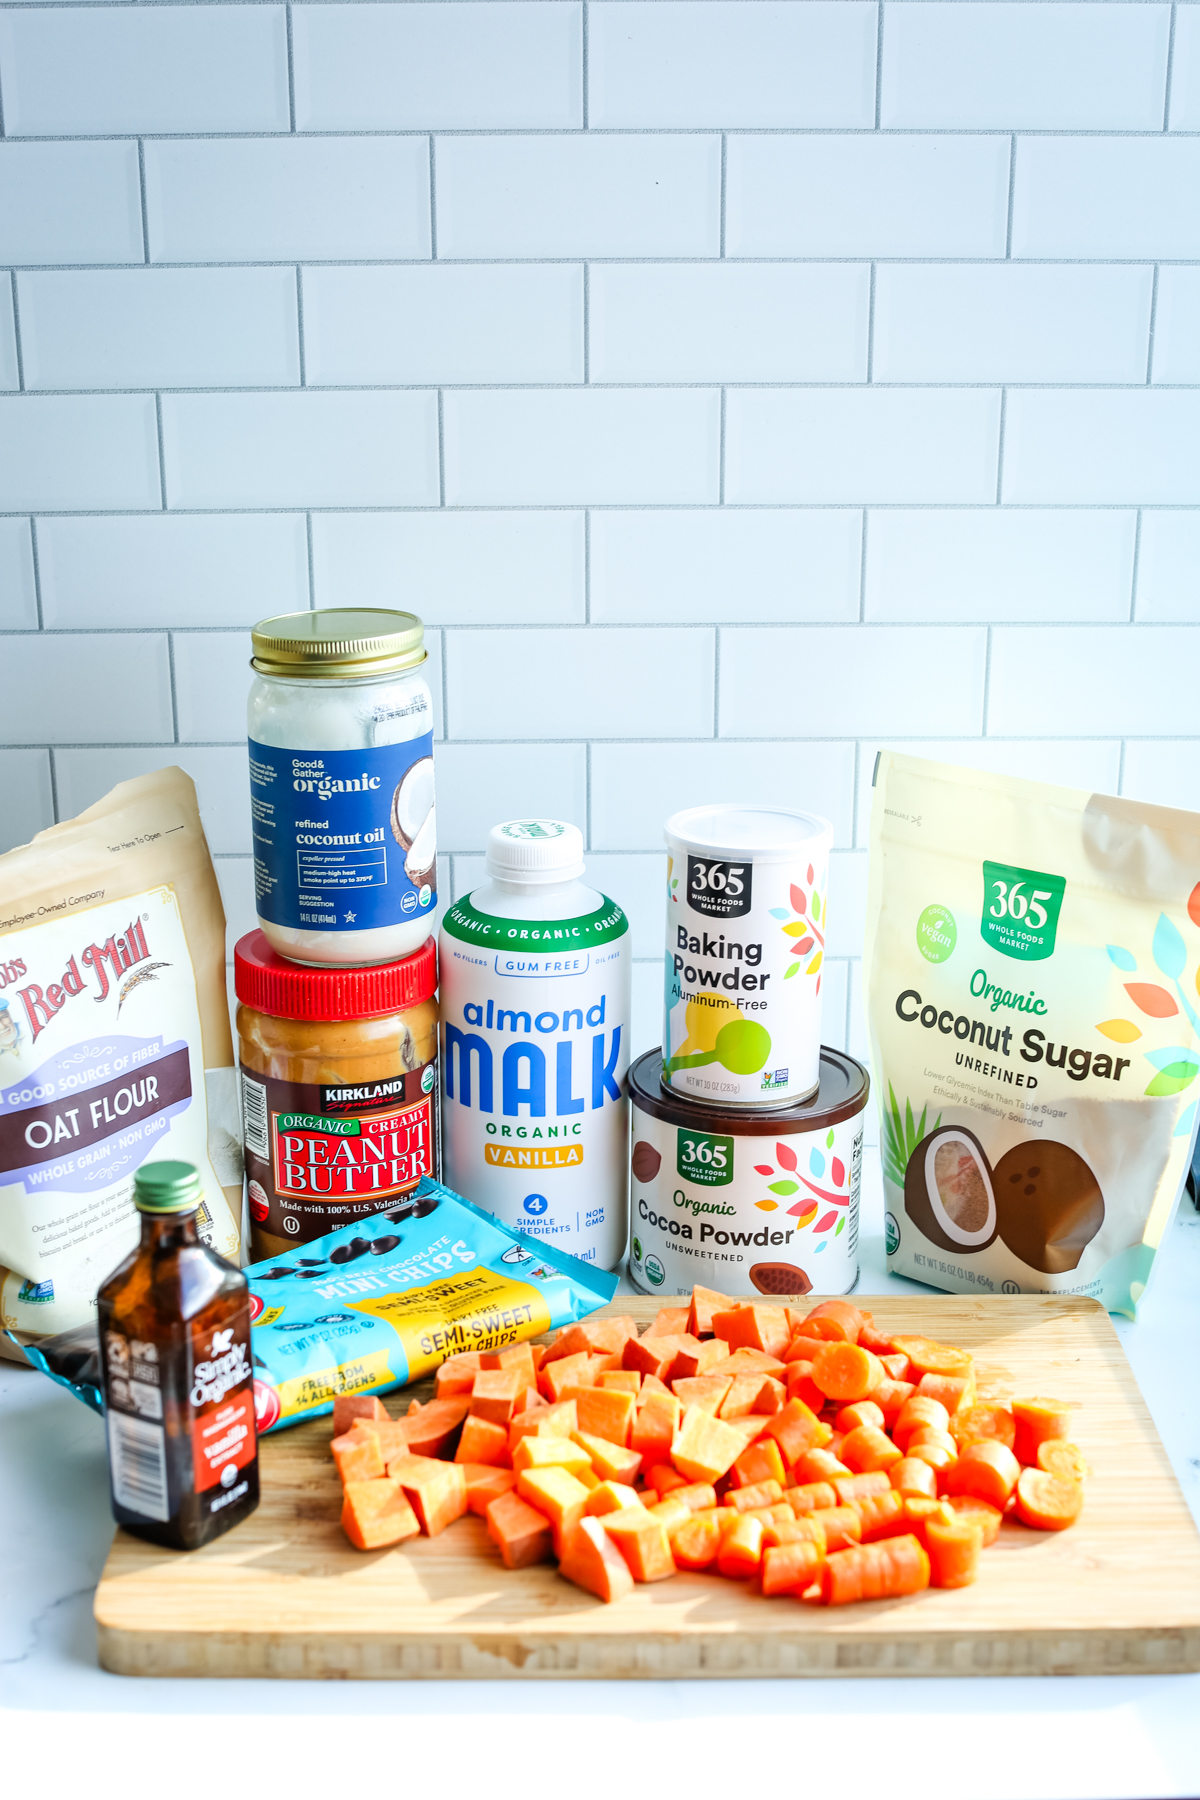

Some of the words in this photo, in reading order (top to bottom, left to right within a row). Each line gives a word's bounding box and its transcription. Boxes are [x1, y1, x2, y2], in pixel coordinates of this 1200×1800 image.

[292, 768, 325, 778] Gather
[293, 773, 381, 801] organic
[295, 819, 329, 829] refined
[296, 832, 362, 846] coconut
[364, 827, 385, 844] oil
[120, 840, 136, 850] Here
[135, 836, 145, 846] To
[144, 832, 162, 842] Open
[692, 863, 744, 895] 365
[68, 888, 105, 907] Company
[691, 893, 715, 903] WHOLE
[717, 898, 744, 906] FOODS
[701, 903, 731, 912] MARKET
[989, 880, 1052, 929] 365
[451, 909, 492, 934] ORGANIC
[507, 928, 581, 939] ORGANIC
[928, 907, 954, 927] COCONUT
[677, 924, 763, 966] Baking
[921, 922, 952, 948] vegan
[988, 922, 1015, 937] WHOLE
[1016, 931, 1044, 945] FOODS
[998, 935, 1030, 952] MARKET
[462, 954, 488, 967] FILLERS
[506, 961, 539, 971] GUM
[544, 959, 580, 971] FREE
[608, 951, 621, 961] FREE
[16, 953, 88, 1045] Red
[82, 915, 152, 1003] Mill
[673, 954, 771, 991] Powder
[671, 983, 768, 1011] Aluminum-Free
[969, 968, 1048, 1016] Organic
[463, 994, 606, 1033] almond
[895, 989, 1013, 1057] Coconut
[1019, 1028, 1131, 1082] Sugar
[8, 1083, 55, 1106] GOOD
[58, 1064, 111, 1092] SOURCE
[113, 1057, 130, 1071] OF
[132, 1042, 160, 1066] FIBER
[445, 1021, 622, 1117] MALK
[686, 1076, 695, 1085] NET
[695, 1078, 703, 1087] WT
[704, 1081, 710, 1089] 10
[712, 1082, 719, 1090] OZ
[955, 1052, 1038, 1089] UNREFINED
[325, 1080, 403, 1102] KIRKLAND
[325, 1095, 403, 1111] Signature
[923, 1067, 946, 1081] Lower
[946, 1075, 976, 1093] Glycemic
[977, 1086, 994, 1100] Index
[995, 1093, 1013, 1106] Than
[1015, 1098, 1039, 1112] Table
[1041, 1105, 1068, 1119] Sugar
[24, 1108, 81, 1149] OAT
[89, 1075, 160, 1129] FLOUR
[283, 1115, 352, 1134] ORGANIC
[368, 1107, 425, 1134] CREAMY
[933, 1085, 962, 1103] Ethically
[963, 1096, 969, 1104] &
[969, 1098, 1006, 1120] Sustainably
[1007, 1111, 1044, 1128] Sourced
[282, 1119, 428, 1165] PEANUT
[485, 1123, 582, 1139] ORGANIC
[27, 1163, 75, 1186] WHOLE
[77, 1145, 111, 1169] GRAIN
[118, 1129, 143, 1152] NON
[144, 1117, 167, 1139] GMO
[489, 1147, 579, 1166] VANILLA
[682, 1140, 727, 1168] 365
[283, 1149, 427, 1193] BUTTER
[682, 1165, 703, 1173] WHOLE
[690, 1173, 716, 1181] MARKET
[279, 1200, 302, 1211] Made
[304, 1204, 325, 1214] with
[326, 1205, 351, 1214] 100%
[353, 1203, 372, 1213] U.S.
[374, 1197, 408, 1210] Valencia
[528, 1198, 543, 1212] 4
[586, 1207, 604, 1219] NON
[673, 1189, 737, 1217] Organic
[32, 1225, 46, 1233] Our
[47, 1217, 65, 1228] whole
[65, 1213, 79, 1224] grain
[88, 1203, 100, 1211] flour
[43, 1230, 68, 1243] delicious
[68, 1221, 84, 1234] baked
[100, 1208, 111, 1218] Add
[585, 1216, 605, 1227] GMO
[638, 1199, 693, 1240] Cocoa
[700, 1223, 795, 1246] Powder
[39, 1246, 61, 1258] biscuits
[62, 1240, 72, 1250] and
[345, 1270, 377, 1279] REAL
[378, 1235, 451, 1273] CHOCOLATE
[665, 1241, 744, 1262] UNSWEETENED
[313, 1275, 389, 1299] MINI
[387, 1239, 476, 1283] CHIPS
[914, 1253, 926, 1266] NET
[927, 1257, 937, 1270] WT
[939, 1261, 947, 1273] 16
[947, 1265, 956, 1277] OZ
[976, 1274, 994, 1292] 454g
[444, 1311, 473, 1326] DAIRY
[475, 1303, 500, 1316] FREE
[277, 1343, 296, 1355] NET
[294, 1337, 310, 1351] WT
[476, 1330, 518, 1352] CHIPS
[194, 1343, 247, 1385] Simply
[302, 1375, 330, 1392] FREE
[332, 1364, 364, 1382] FROM
[190, 1362, 252, 1407] Organic
[296, 1395, 308, 1405] 14
[311, 1372, 376, 1401] ALLERGENS
